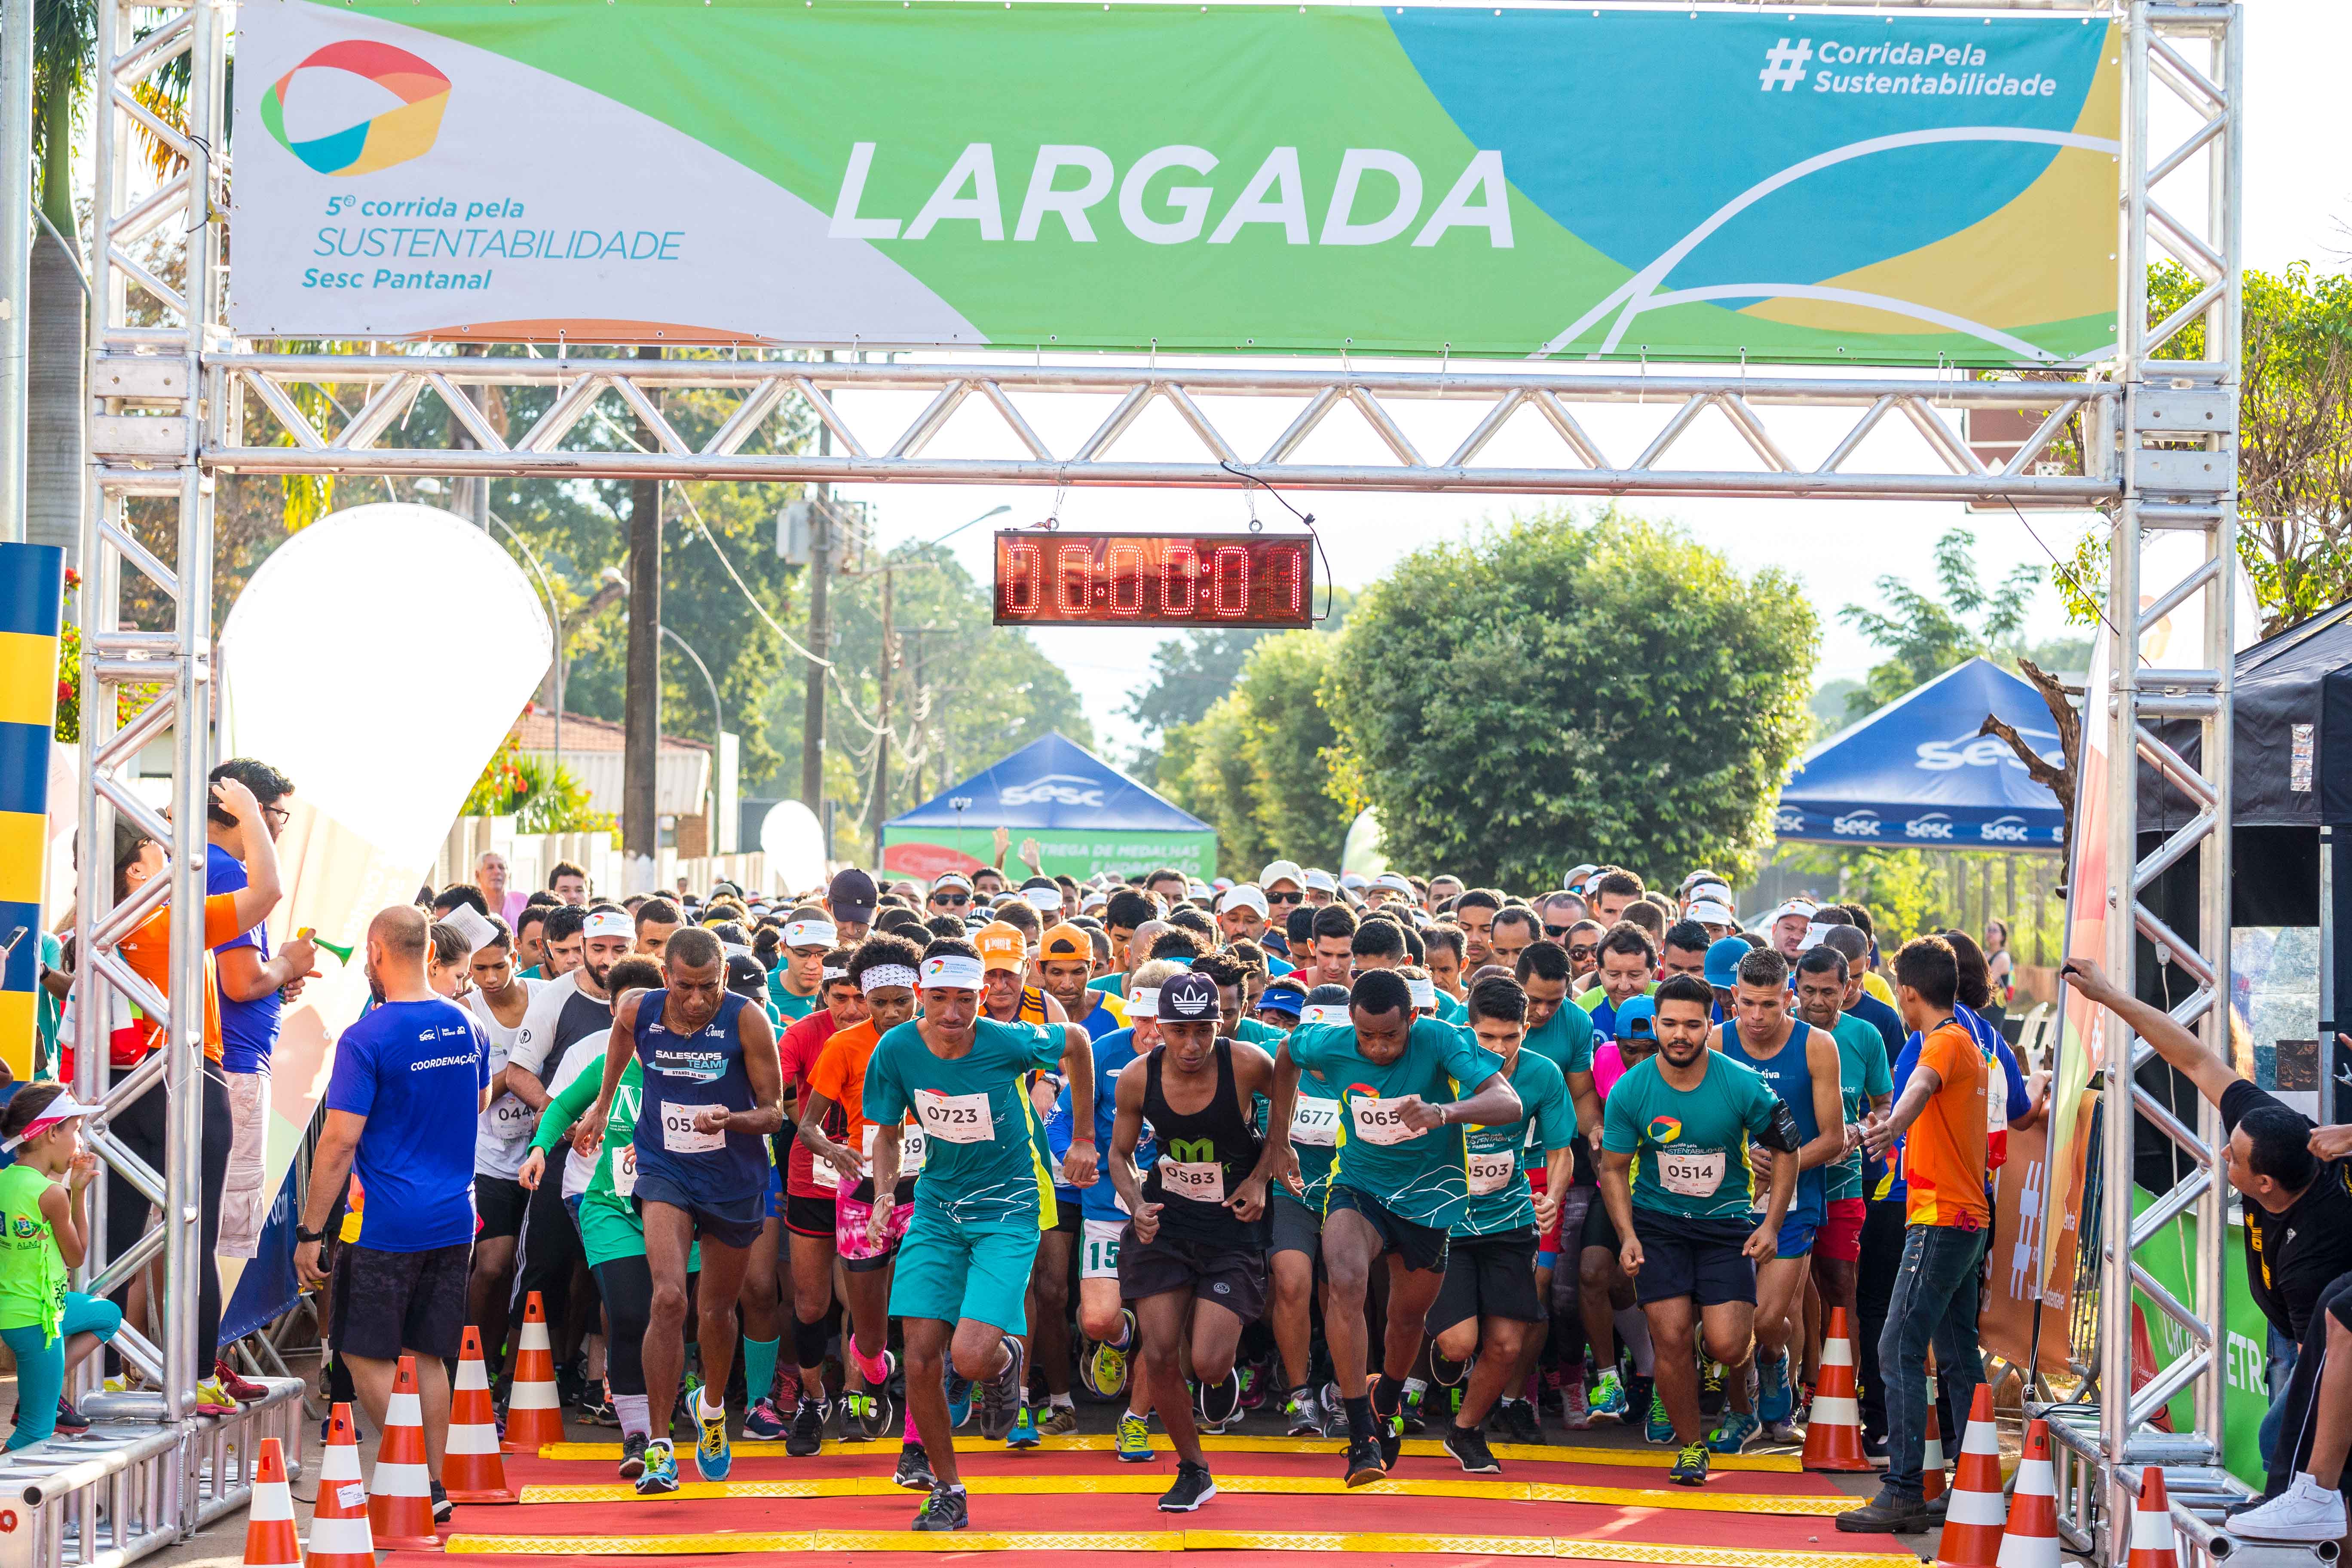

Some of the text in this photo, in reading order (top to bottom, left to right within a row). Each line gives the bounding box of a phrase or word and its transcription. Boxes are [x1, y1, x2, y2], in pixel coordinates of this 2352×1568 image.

[1813, 71, 2056, 97] Sustentabilidade
[827, 142, 1515, 248] LARGADA
[361, 196, 457, 218] corrida
[466, 197, 524, 222] pela
[313, 227, 685, 260] SUSTENTABILIDADE
[302, 268, 492, 290] Sesc Pantanal
[1006, 543, 1301, 616] 00:00:01
[1019, 843, 1200, 858] ETREGA DE MEDALHAS
[1090, 861, 1101, 873] E
[410, 1053, 477, 1071] COORDENAÇÃO
[655, 1050, 722, 1060] SALESCAPS
[686, 1060, 722, 1069] TEAM
[927, 1106, 977, 1123] 0723
[1360, 1111, 1401, 1126] 065
[1166, 1167, 1215, 1185] 0583
[1668, 1165, 1713, 1179] 0514
[1090, 1241, 1120, 1271] 15
